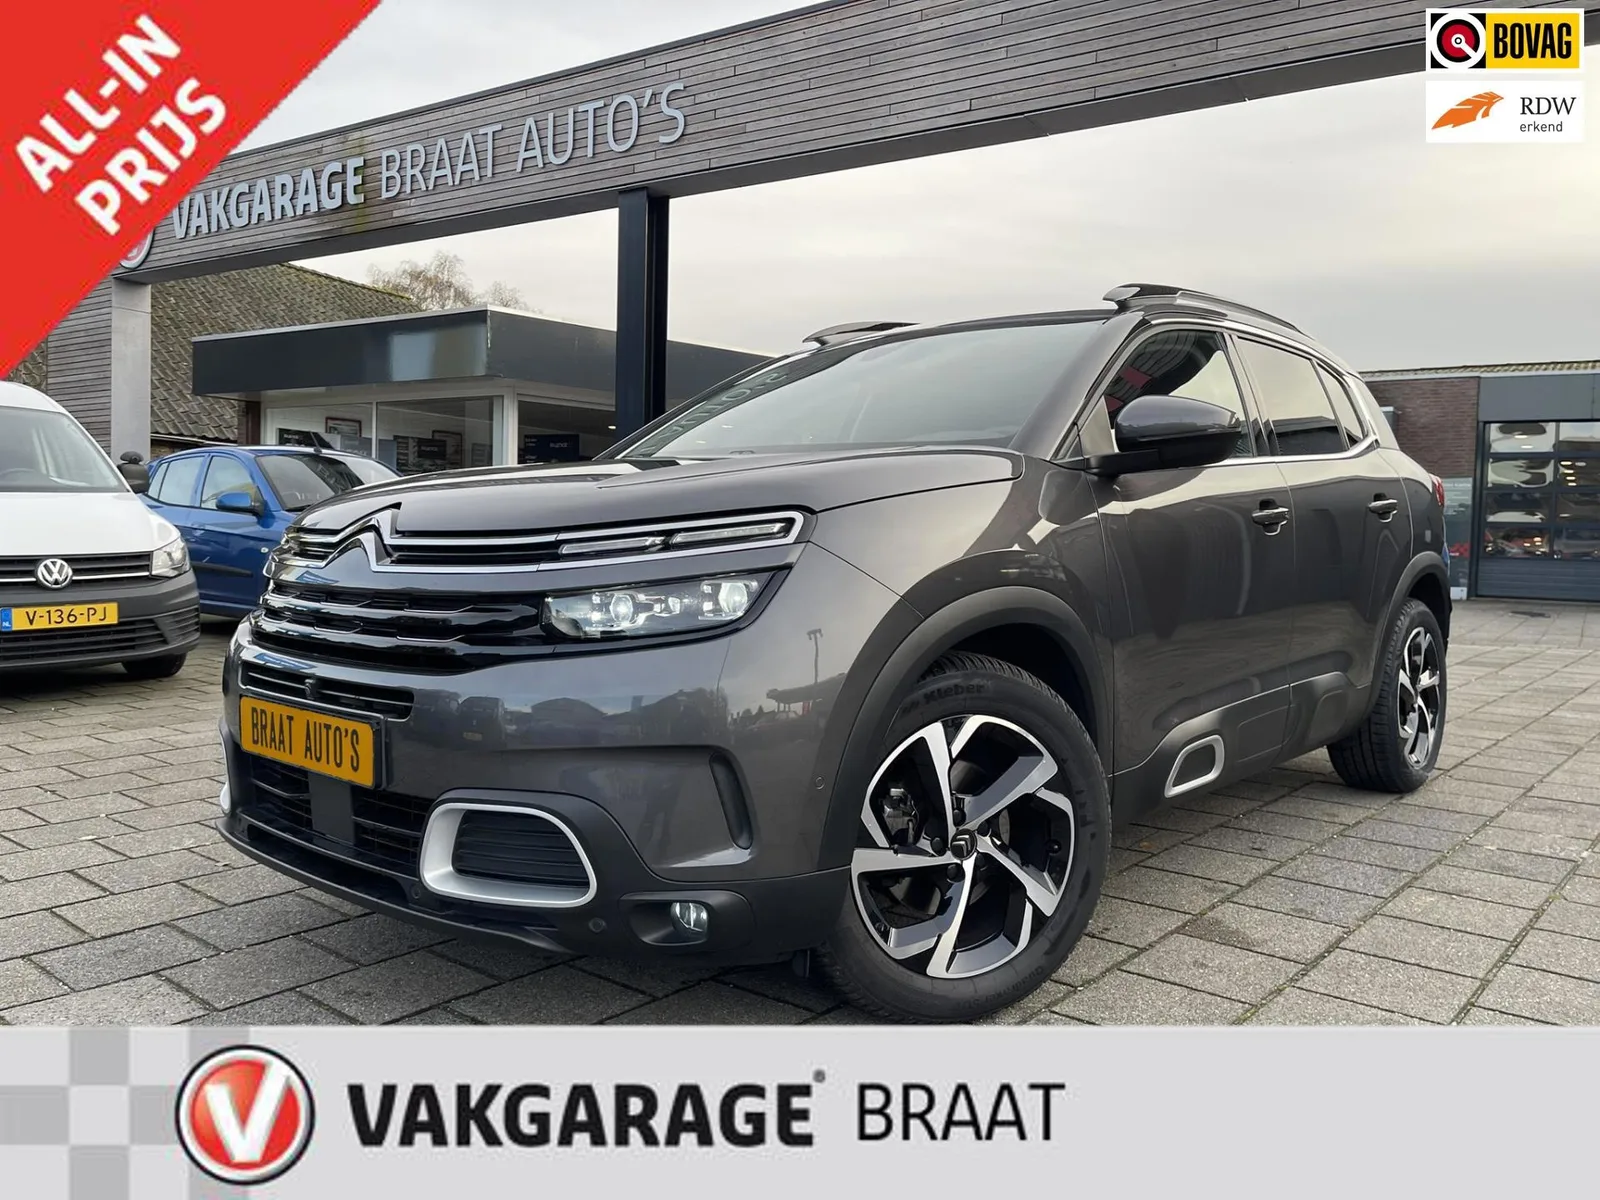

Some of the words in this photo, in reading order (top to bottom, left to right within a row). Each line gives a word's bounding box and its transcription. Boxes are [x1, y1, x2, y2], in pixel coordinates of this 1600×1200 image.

[172, 156, 365, 240] VAKGARAGE
[380, 123, 503, 199] BRAAT
[516, 82, 686, 173] AUTO'S
[25, 606, 107, 626] V-136-PJ
[251, 706, 294, 755] BRAAT
[304, 719, 360, 773] AUTO'S
